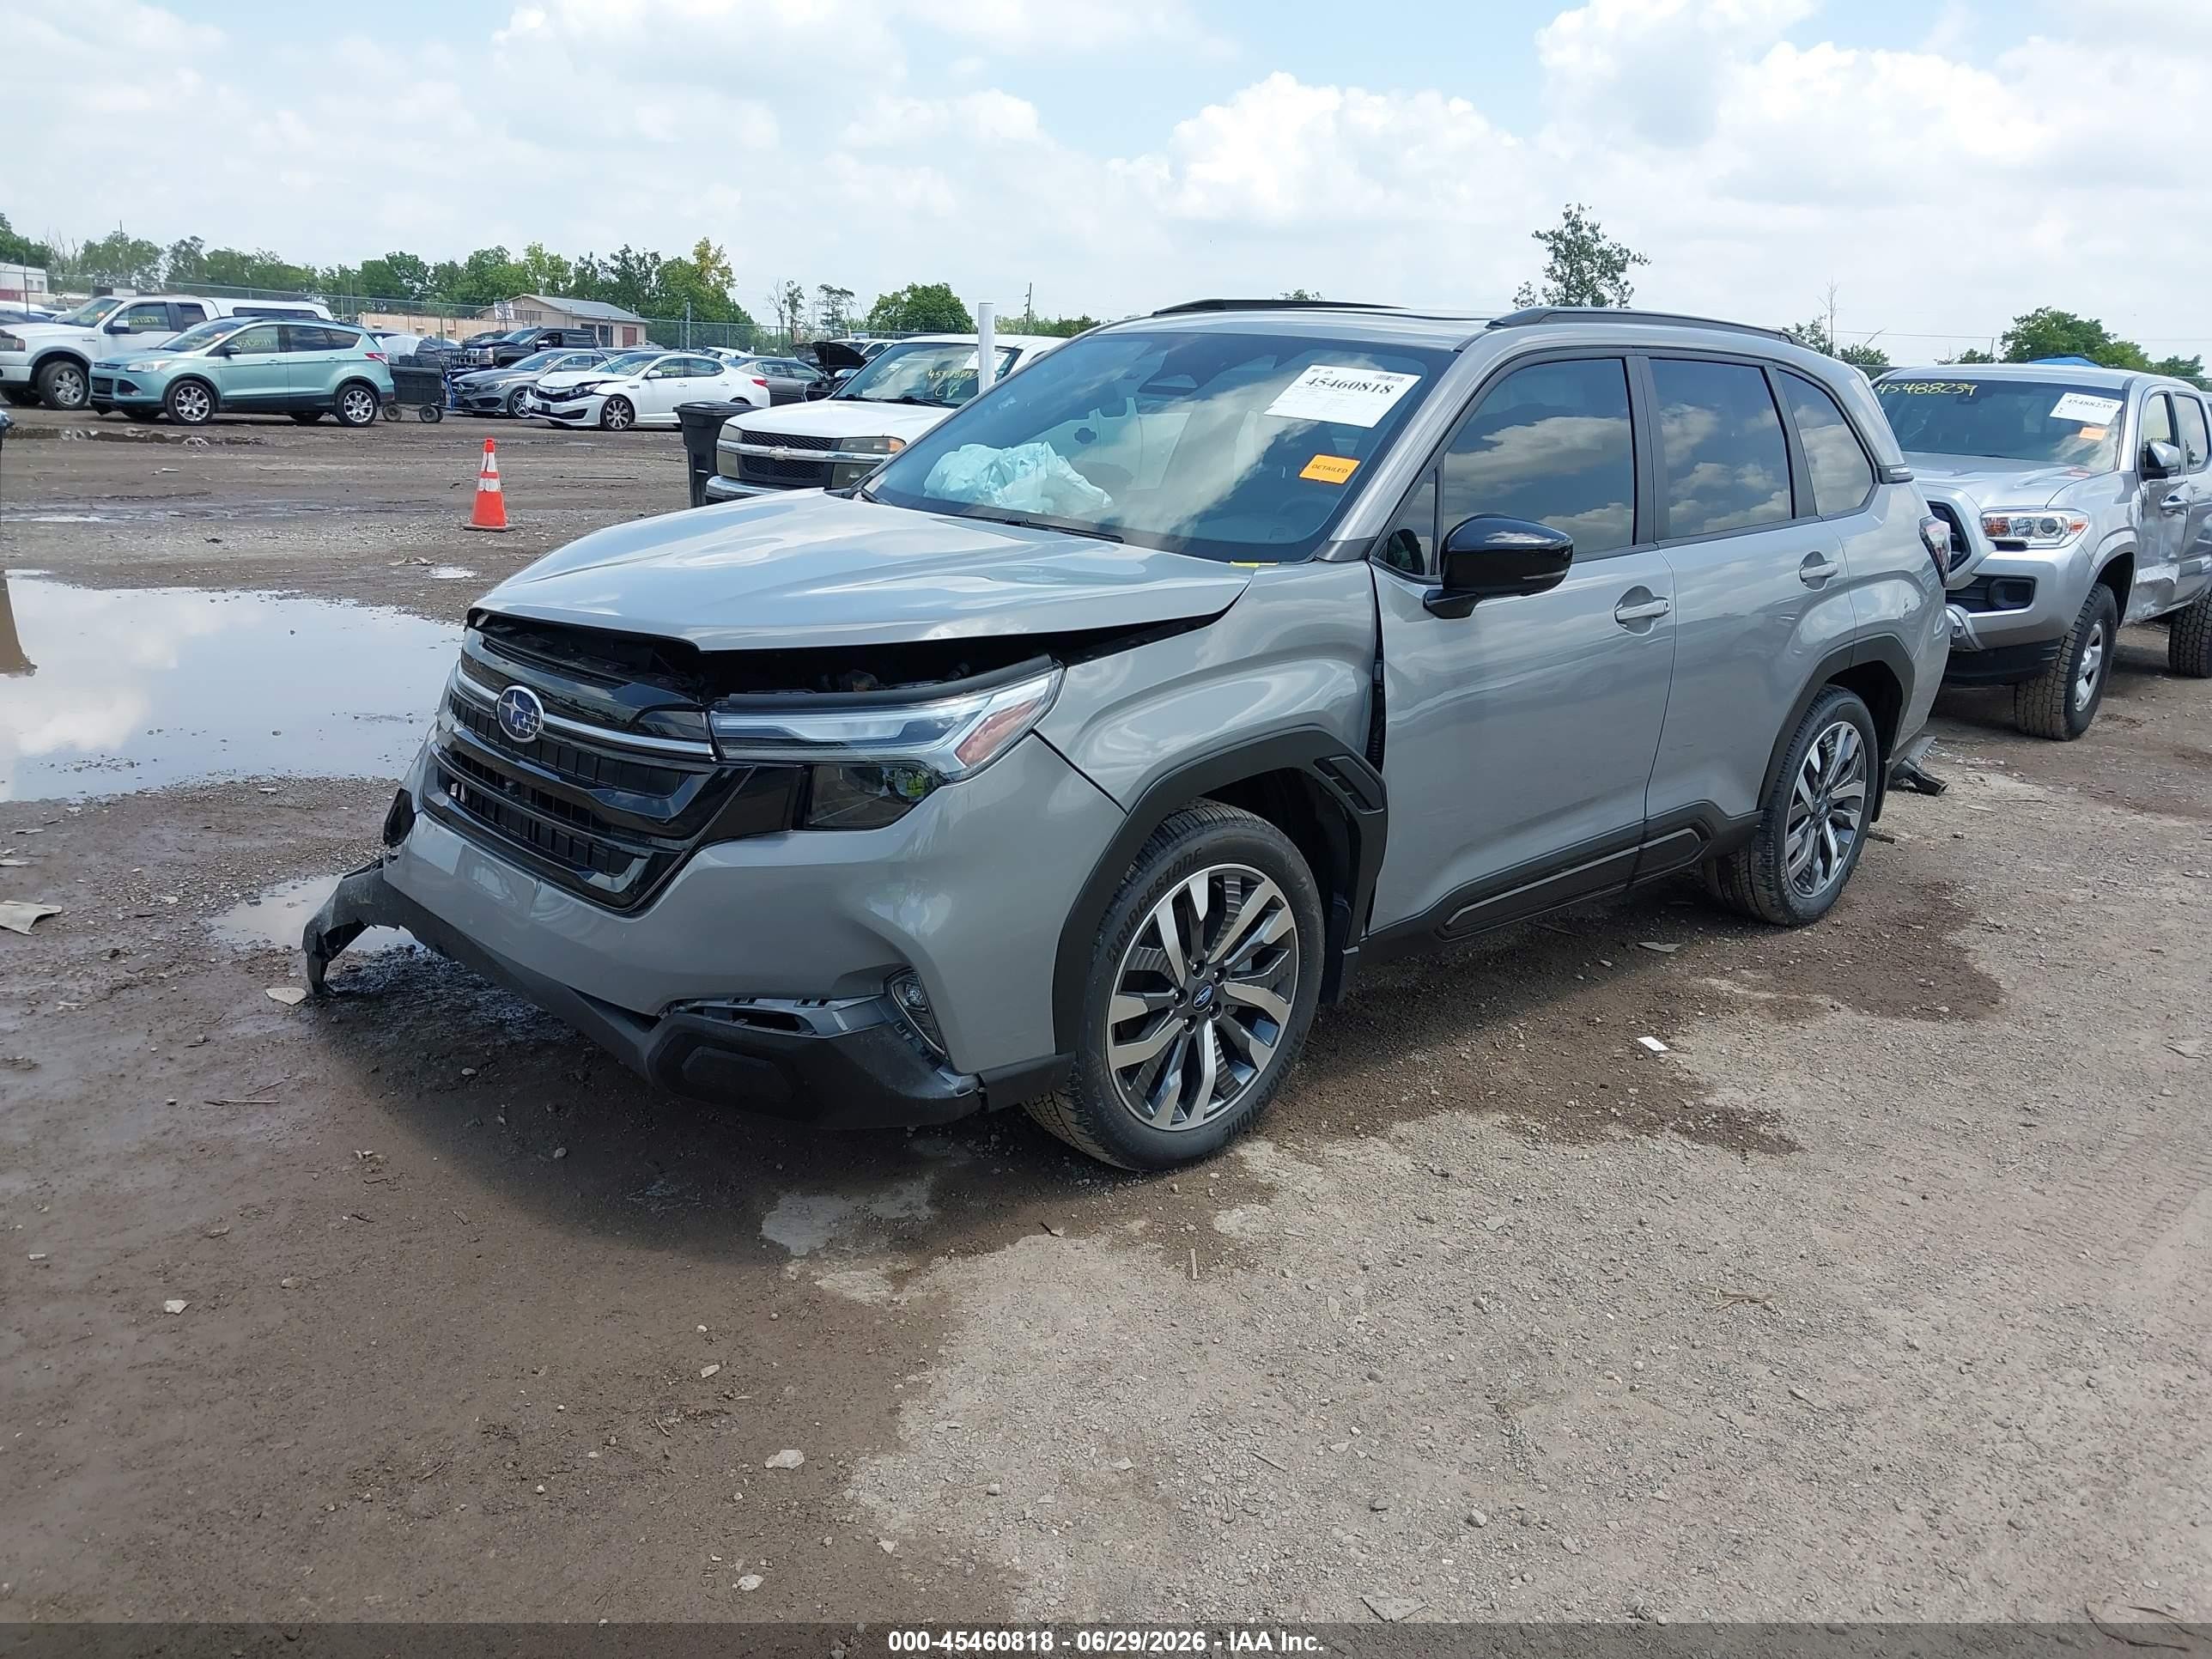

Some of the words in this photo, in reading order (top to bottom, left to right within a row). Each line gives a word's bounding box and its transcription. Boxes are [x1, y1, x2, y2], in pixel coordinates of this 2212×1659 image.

[1304, 376, 1395, 395] 45460818
[1877, 382, 1978, 397] 45488239
[1311, 464, 1348, 474] DETAILED
[1104, 846, 1202, 965] BRIDGESTONE
